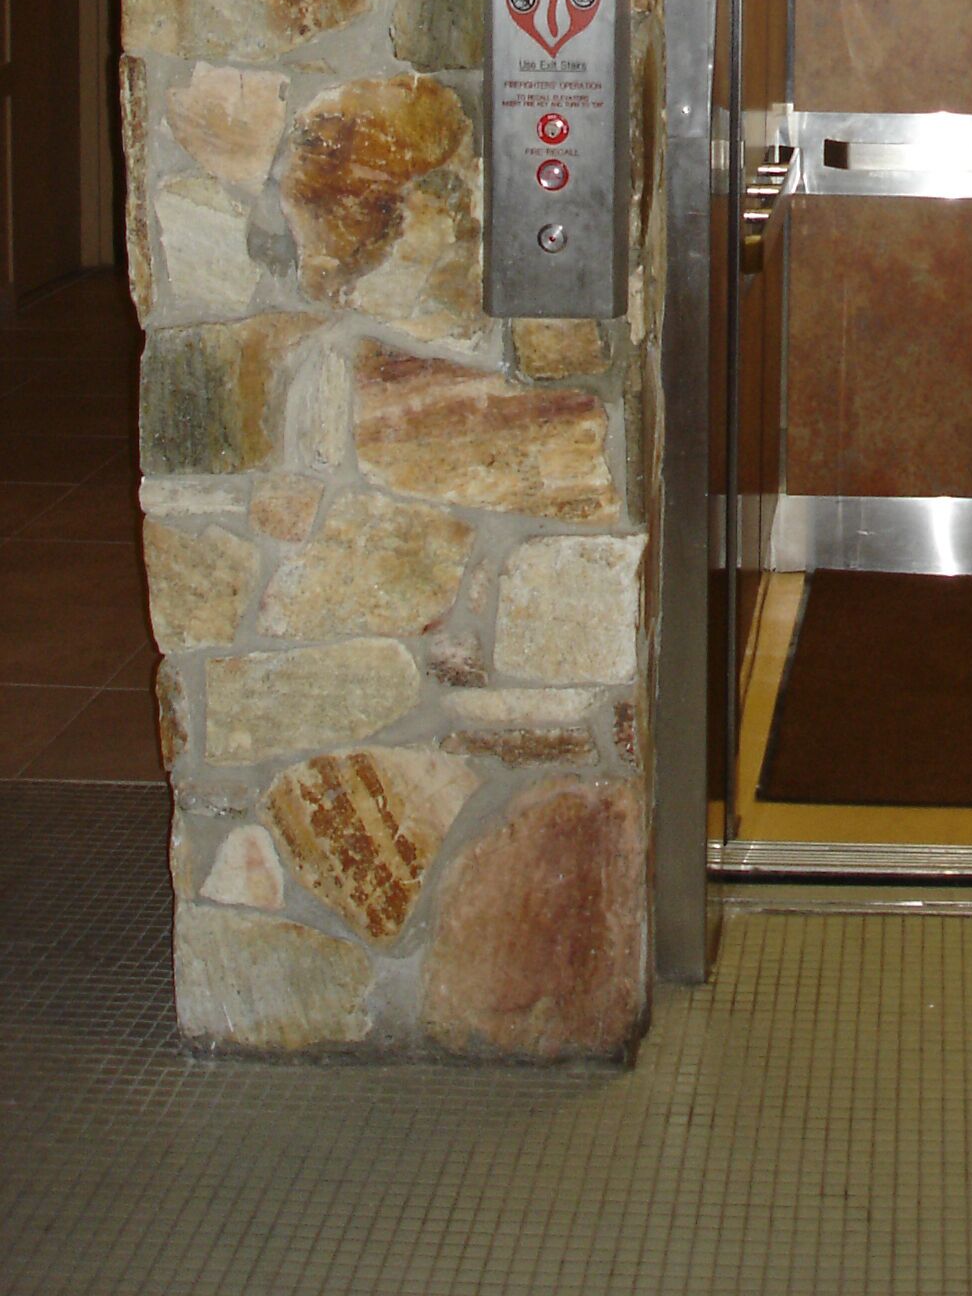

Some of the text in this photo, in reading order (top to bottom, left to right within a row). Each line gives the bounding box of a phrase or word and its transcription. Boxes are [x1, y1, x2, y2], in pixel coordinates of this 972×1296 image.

[519, 60, 587, 72] Use Exit Stairs
[546, 148, 580, 156] RECALL
